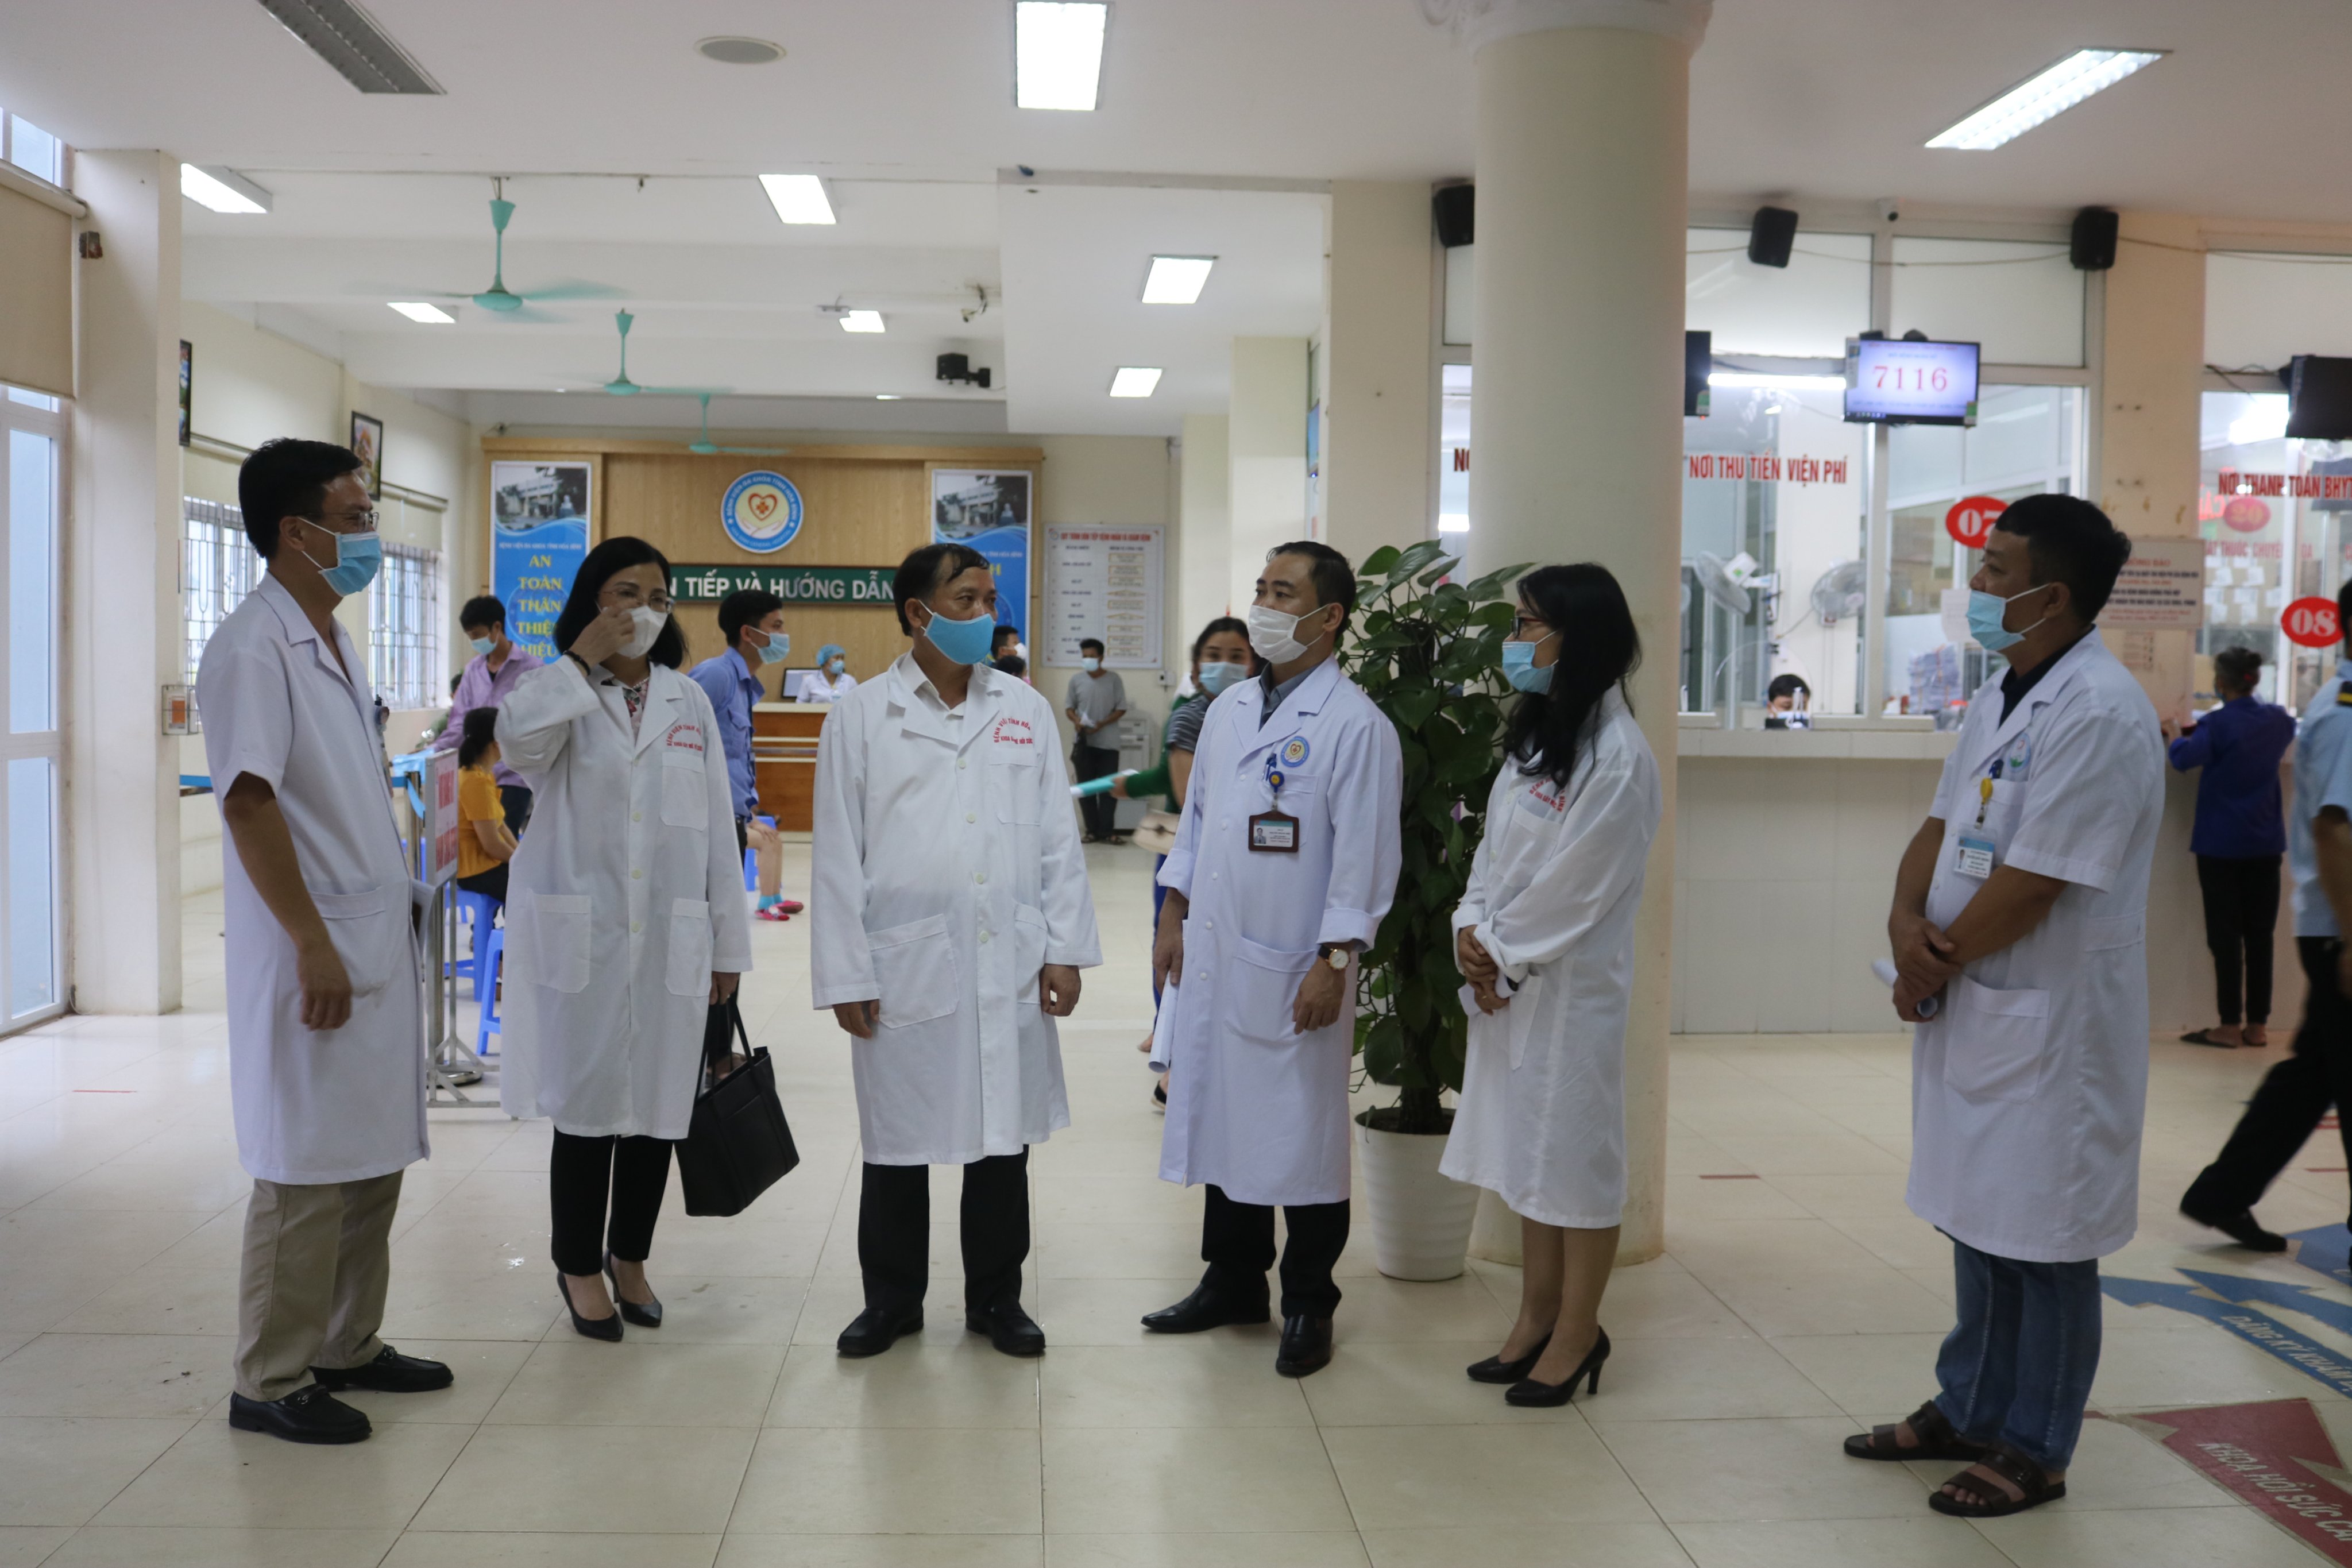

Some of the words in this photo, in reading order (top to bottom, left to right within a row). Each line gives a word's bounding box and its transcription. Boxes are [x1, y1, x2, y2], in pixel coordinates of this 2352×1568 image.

[1874, 366, 1948, 392] 7116
[1689, 454, 1714, 479] NƠI
[1718, 455, 1745, 479] THU
[1787, 453, 1819, 488] VIỆN
[1823, 454, 1848, 484] PHÍ
[2244, 474, 2284, 497] THANH
[2289, 469, 2321, 498] TOÁN
[528, 555, 552, 568] AN
[517, 574, 562, 590] TOÀN
[684, 568, 731, 598] TIẾP
[735, 570, 763, 591] VÀ
[770, 571, 845, 600] HƯỚNG
[2291, 607, 2336, 638] 08
[2196, 1442, 2268, 1472] KHOA
[2275, 1494, 2343, 1519] SỨC
